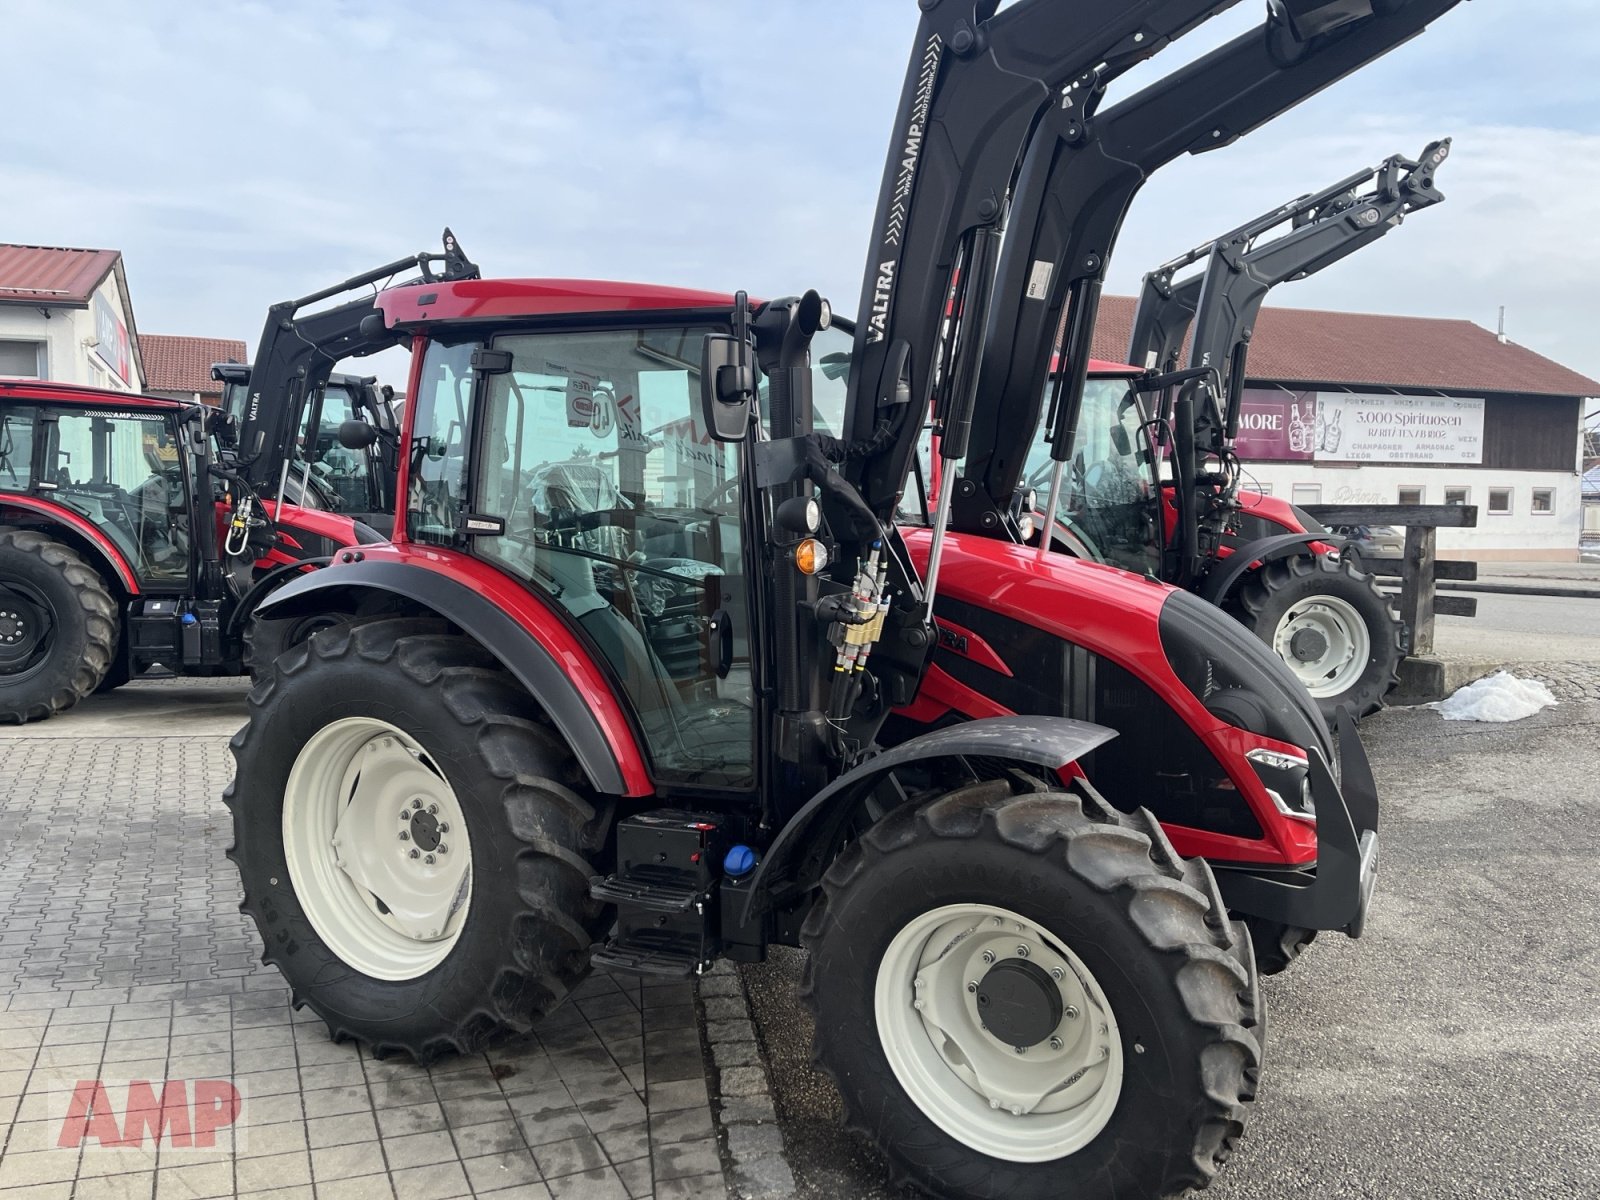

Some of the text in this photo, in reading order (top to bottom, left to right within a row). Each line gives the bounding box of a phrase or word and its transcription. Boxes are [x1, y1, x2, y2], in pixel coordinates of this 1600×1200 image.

[866, 259, 897, 345] VALTRA
[249, 392, 261, 421] VALTRA
[1238, 413, 1284, 431] MORE
[1394, 412, 1462, 427] Spirituosen
[1351, 443, 1403, 451] CHAMPAGNER
[1389, 452, 1434, 460] OBSTBRAND
[1460, 451, 1477, 459] GIN
